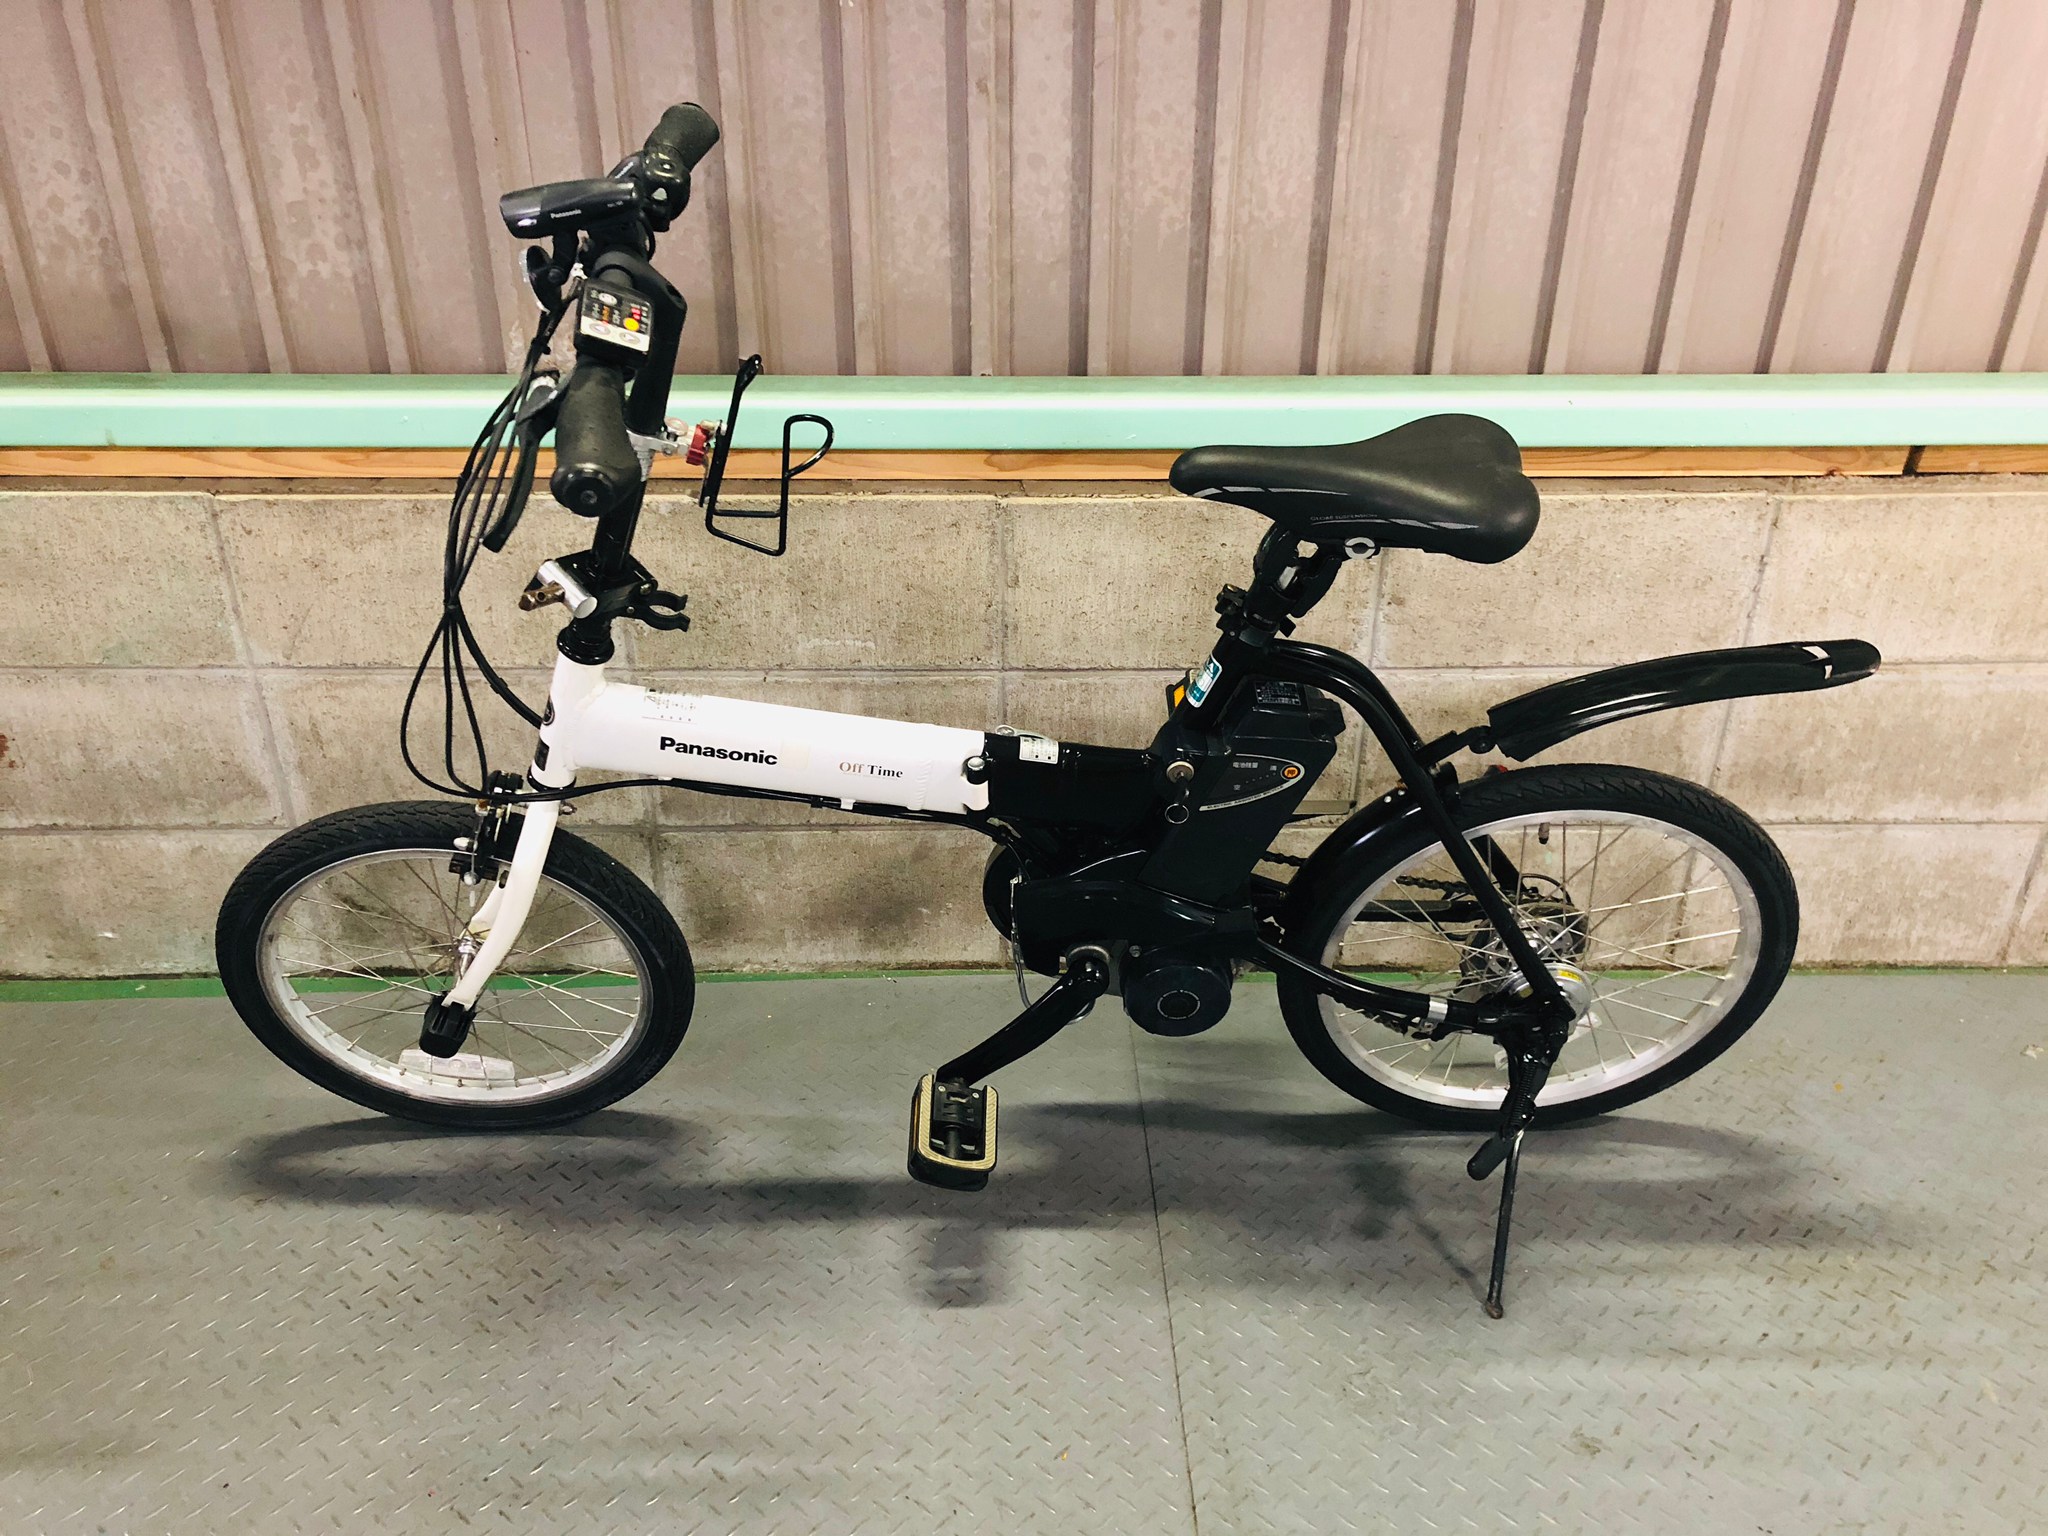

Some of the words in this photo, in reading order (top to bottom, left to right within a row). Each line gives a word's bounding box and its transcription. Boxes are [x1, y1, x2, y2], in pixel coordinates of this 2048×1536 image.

[550, 208, 582, 219] Panasonic
[659, 736, 778, 766] Panasonic
[839, 761, 865, 774] Off
[868, 764, 904, 778] Time
